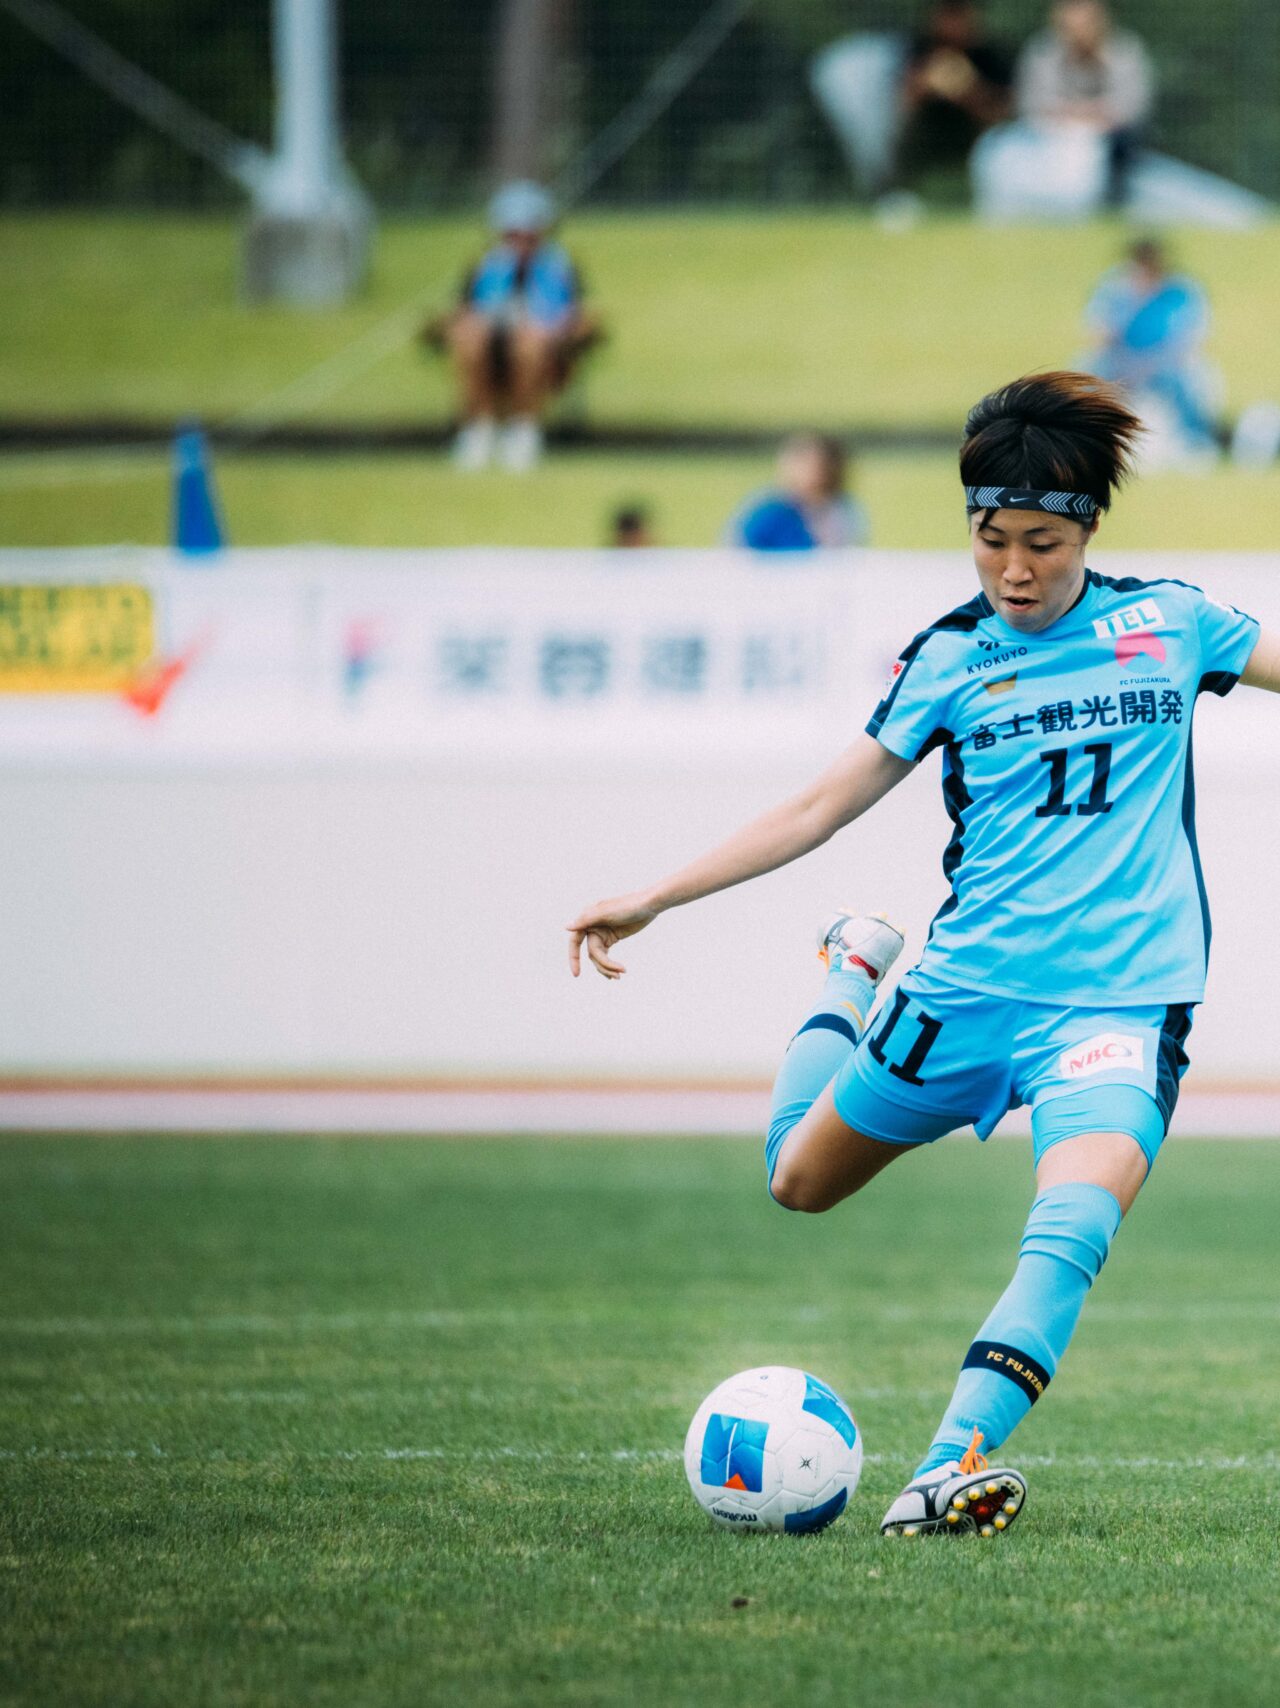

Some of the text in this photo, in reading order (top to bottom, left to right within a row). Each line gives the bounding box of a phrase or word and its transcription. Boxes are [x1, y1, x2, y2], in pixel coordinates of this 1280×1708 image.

[1100, 607, 1157, 637] TEL
[966, 646, 1028, 675] KYOKUYO
[971, 689, 1184, 751] 富士観光開発
[1035, 742, 1114, 818] 11
[867, 984, 944, 1088] 11
[1069, 1043, 1118, 1074] NBC
[986, 1350, 1005, 1362] FC
[712, 1506, 758, 1522] molten
